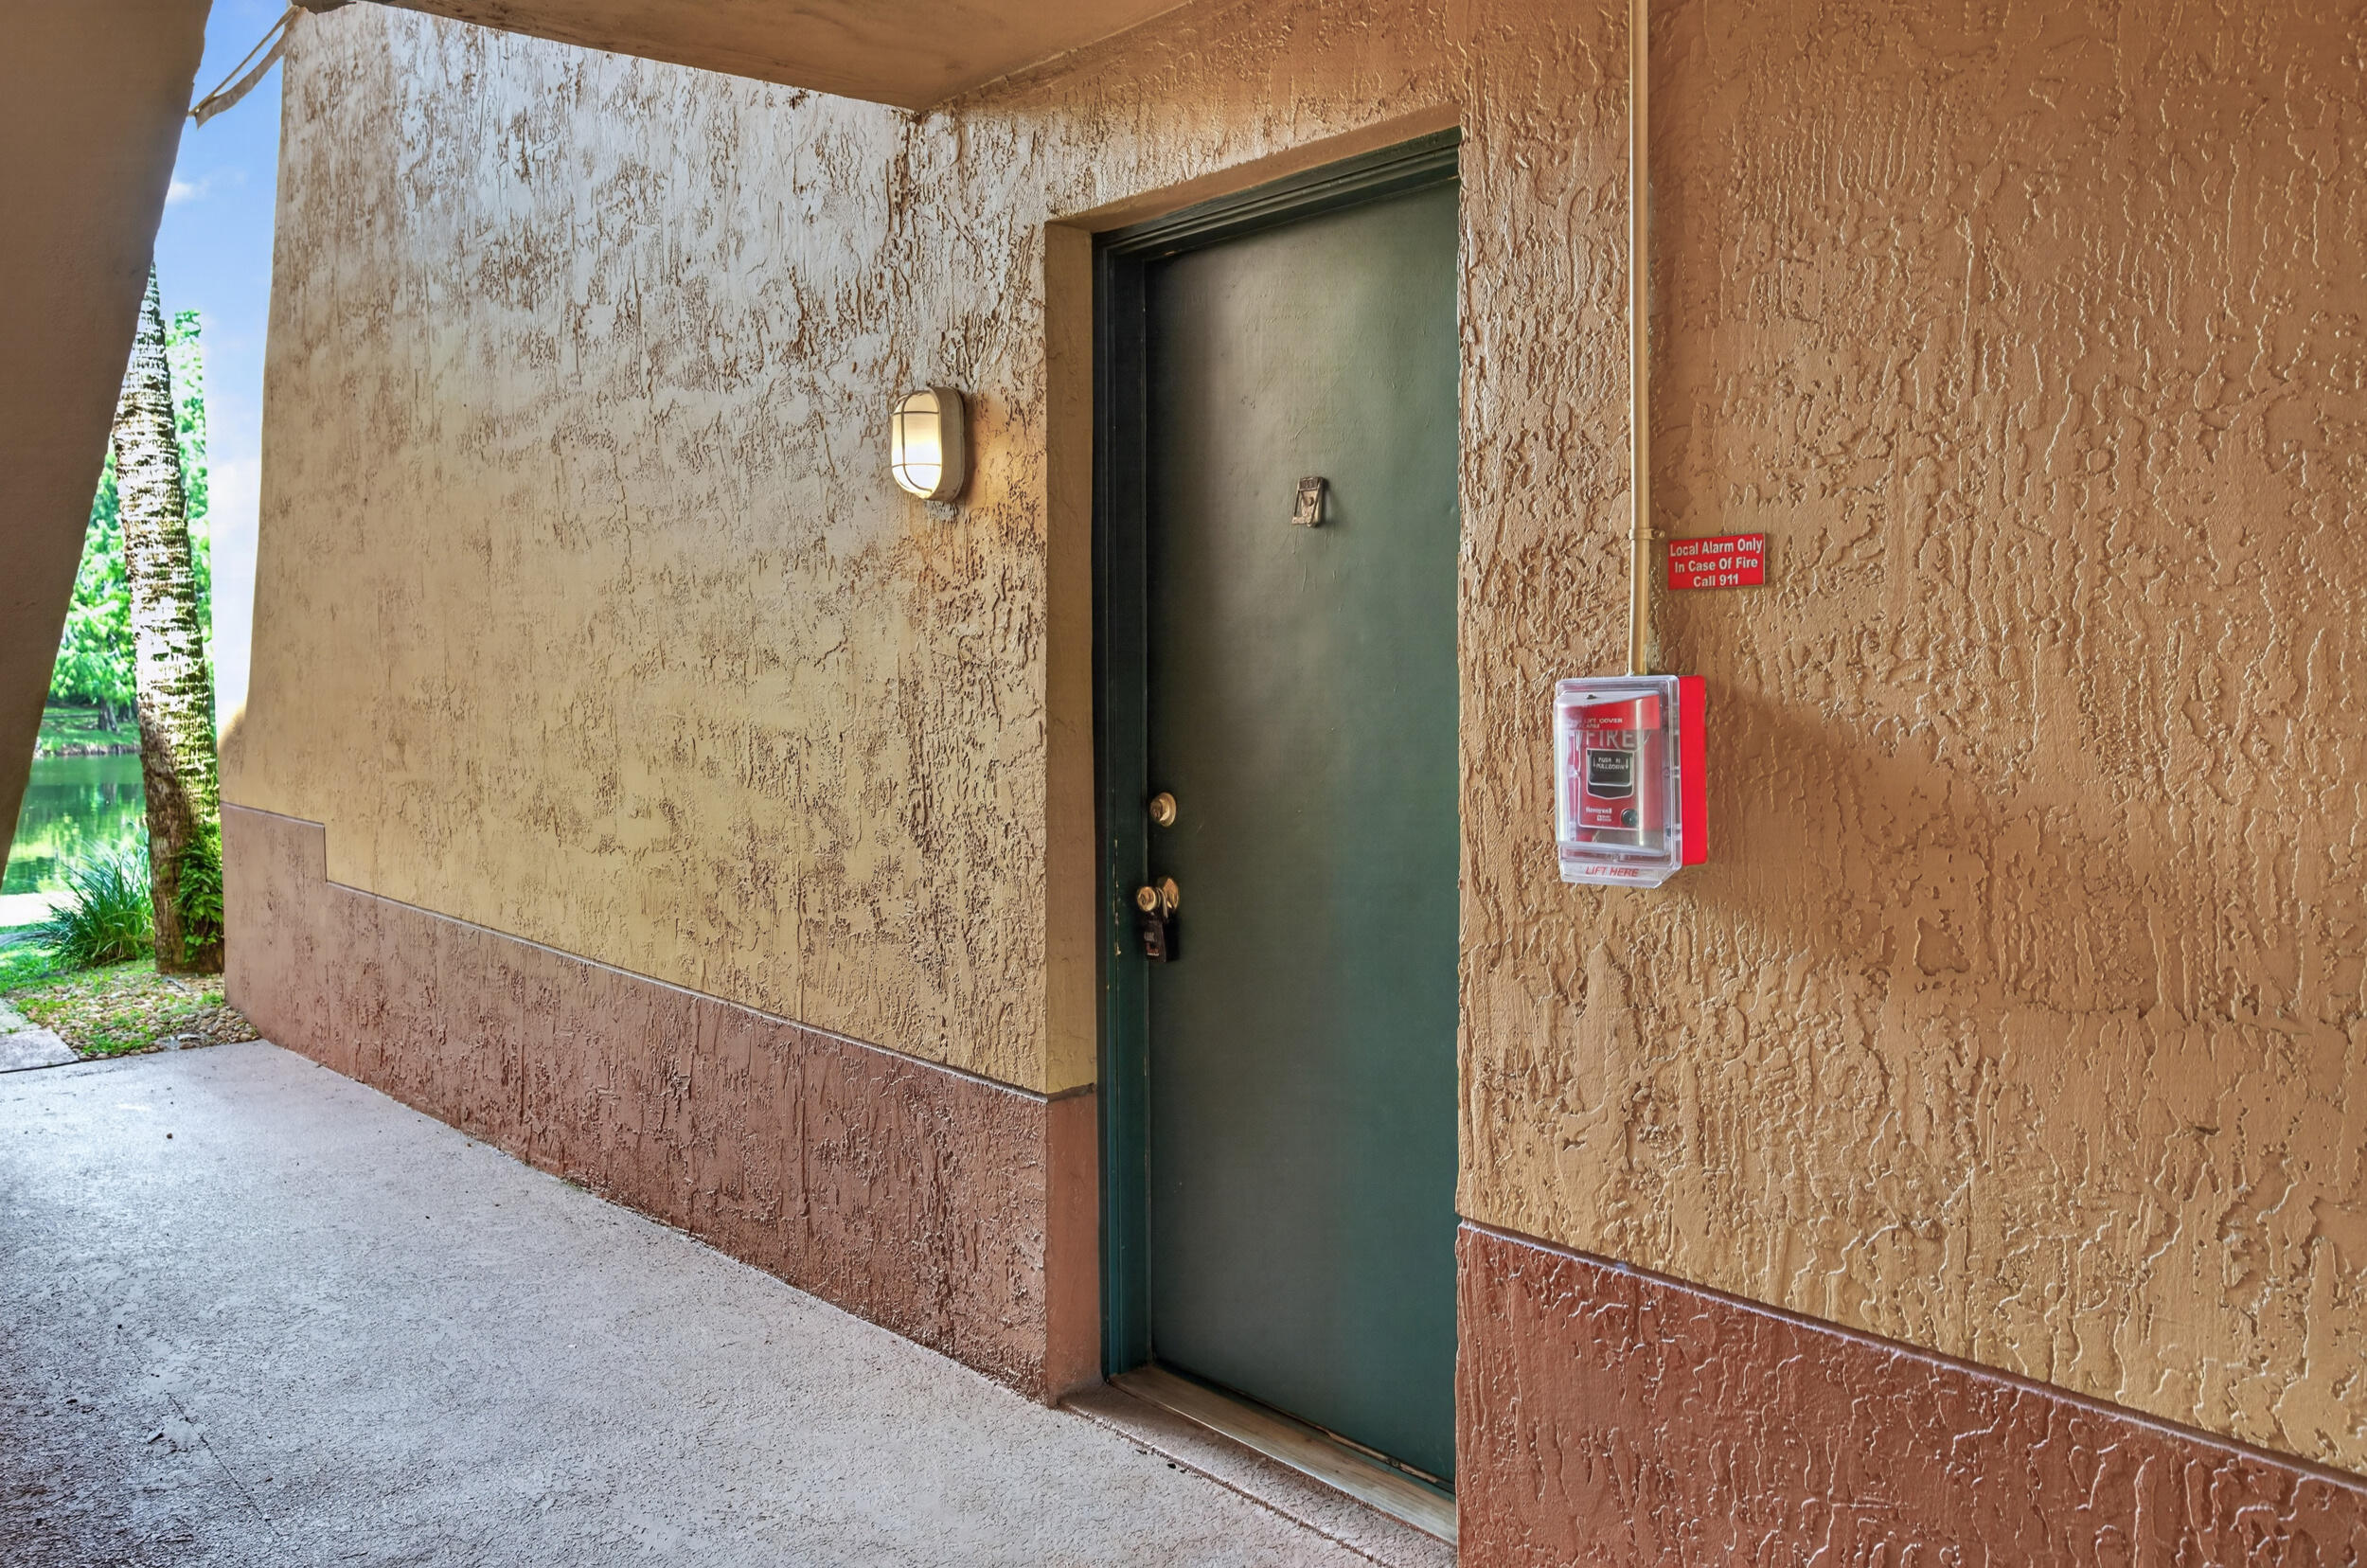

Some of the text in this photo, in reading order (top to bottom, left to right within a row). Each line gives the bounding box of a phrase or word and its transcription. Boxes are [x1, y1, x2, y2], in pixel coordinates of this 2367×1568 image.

[1670, 538, 1763, 557] Local Alarm Only
[1675, 557, 1758, 573] In Case Of Fire
[1693, 573, 1738, 587] Call 911
[1585, 865, 1639, 877] LIFT HERE
